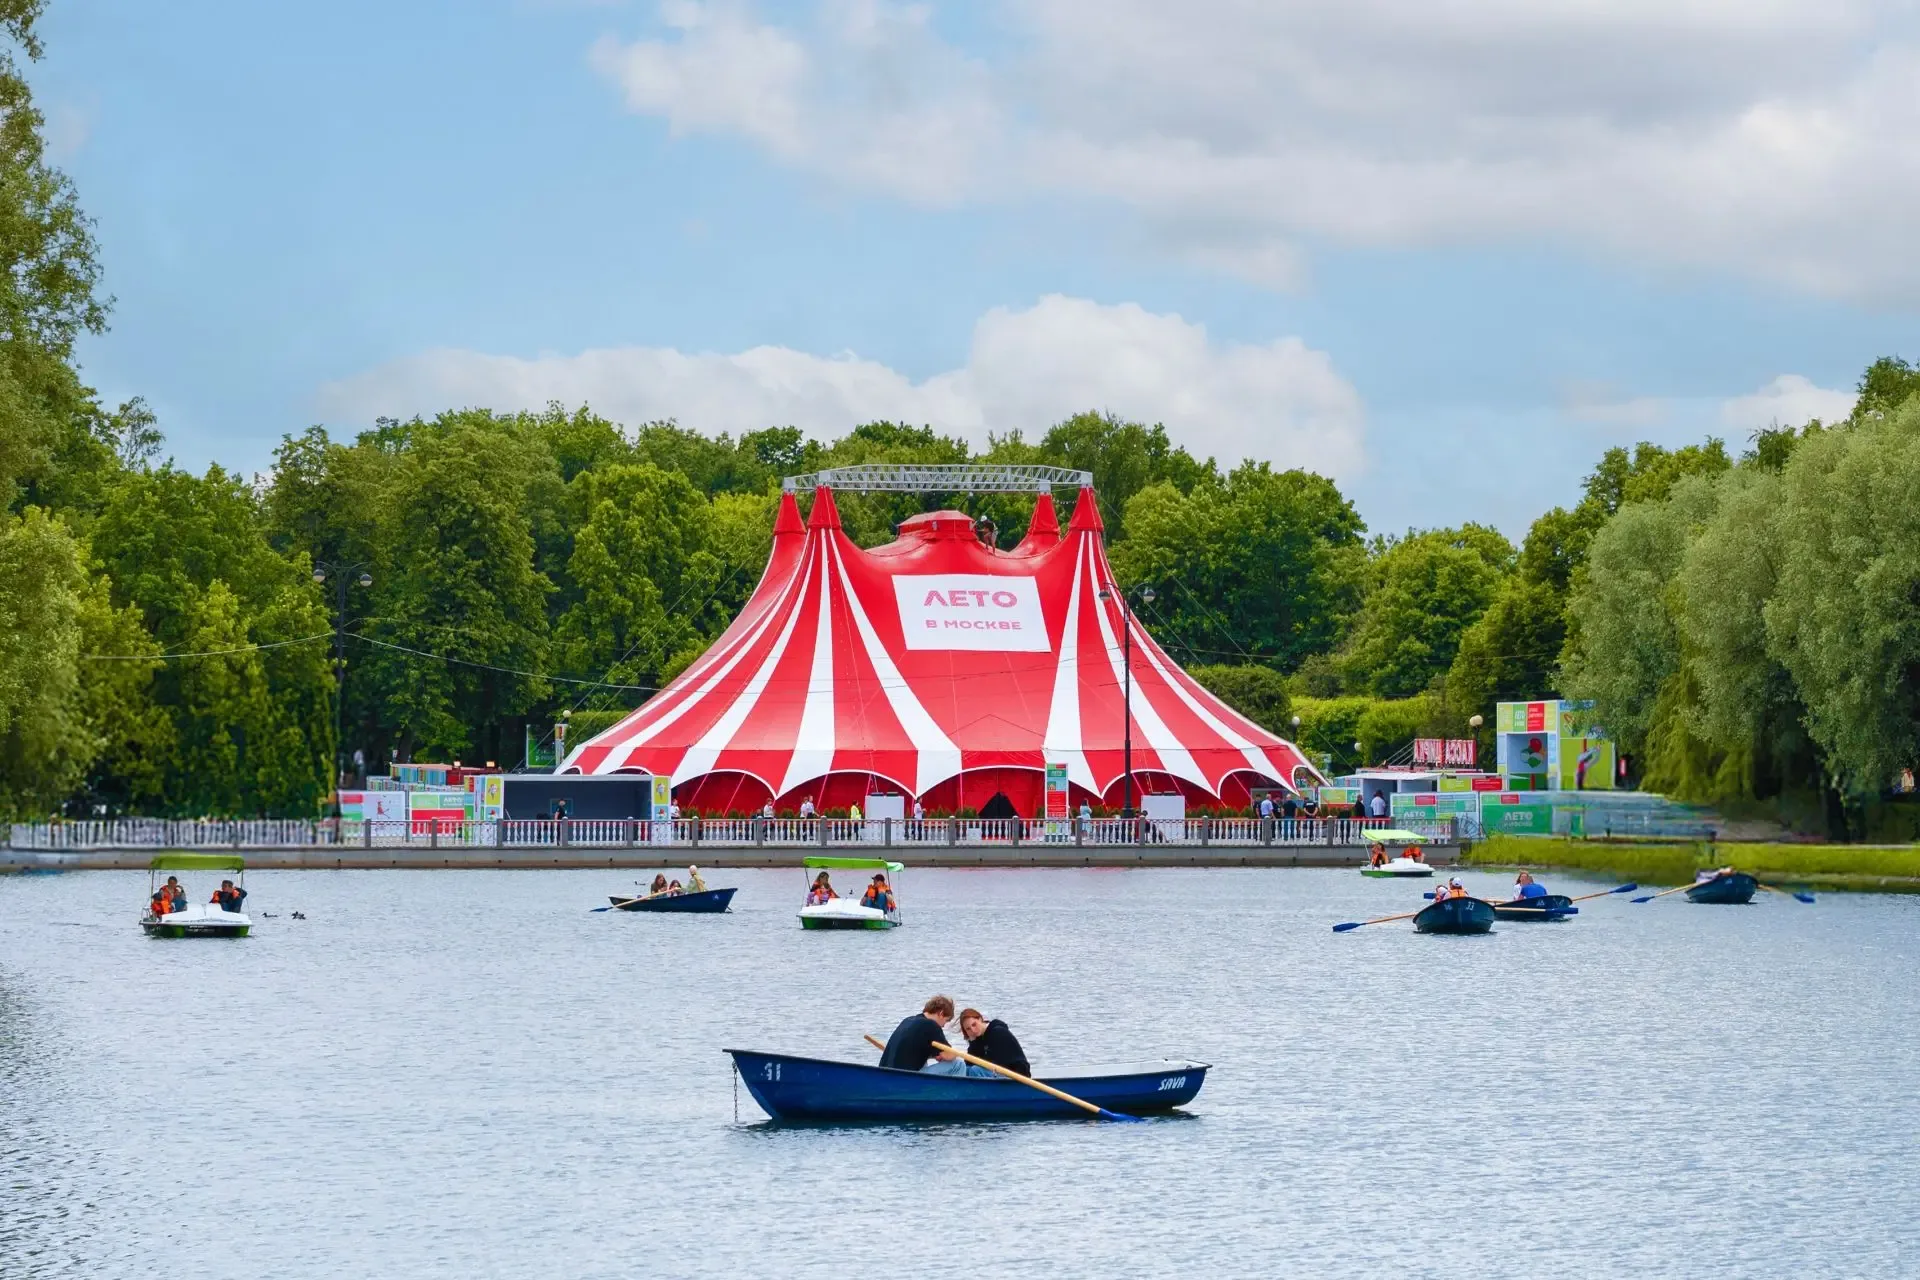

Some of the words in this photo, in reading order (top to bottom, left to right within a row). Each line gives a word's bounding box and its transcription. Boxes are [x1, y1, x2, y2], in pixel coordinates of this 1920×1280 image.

[924, 590, 1018, 608] ЛЕТО
[926, 619, 938, 629] В
[943, 619, 1023, 630] МОСКВЕ
[1504, 811, 1533, 821] ЛЕТО
[1158, 1076, 1186, 1091] SAVA
